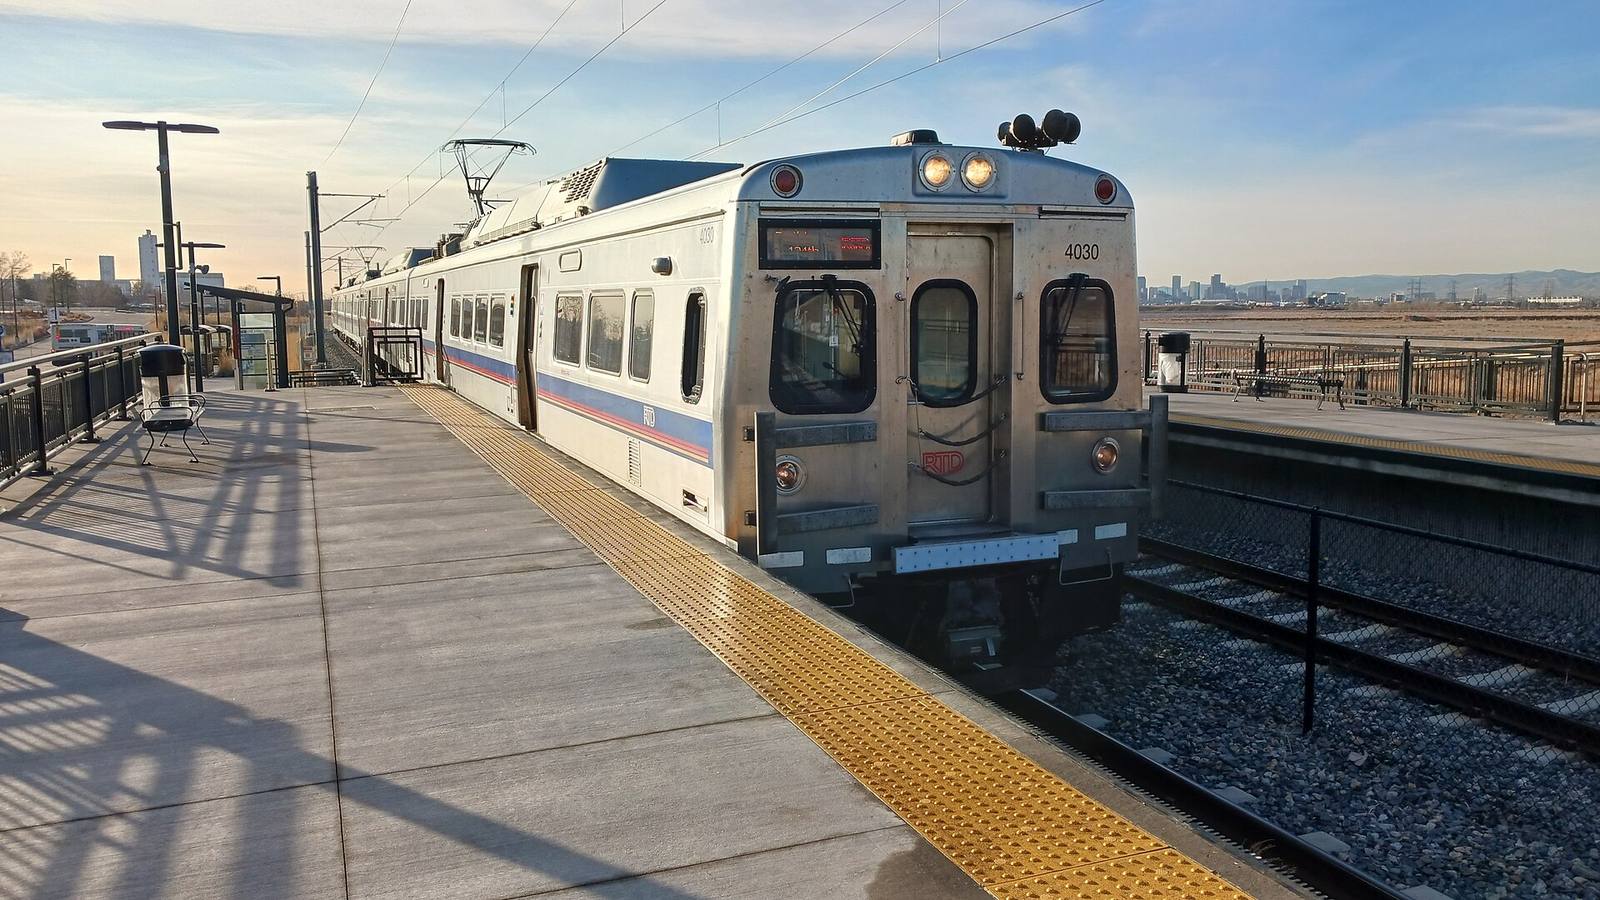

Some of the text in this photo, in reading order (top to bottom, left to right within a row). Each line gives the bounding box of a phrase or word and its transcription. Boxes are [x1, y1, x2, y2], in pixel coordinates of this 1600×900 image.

[1065, 243, 1099, 260] 4030
[643, 405, 655, 428] RTD
[922, 450, 964, 474] RTD
